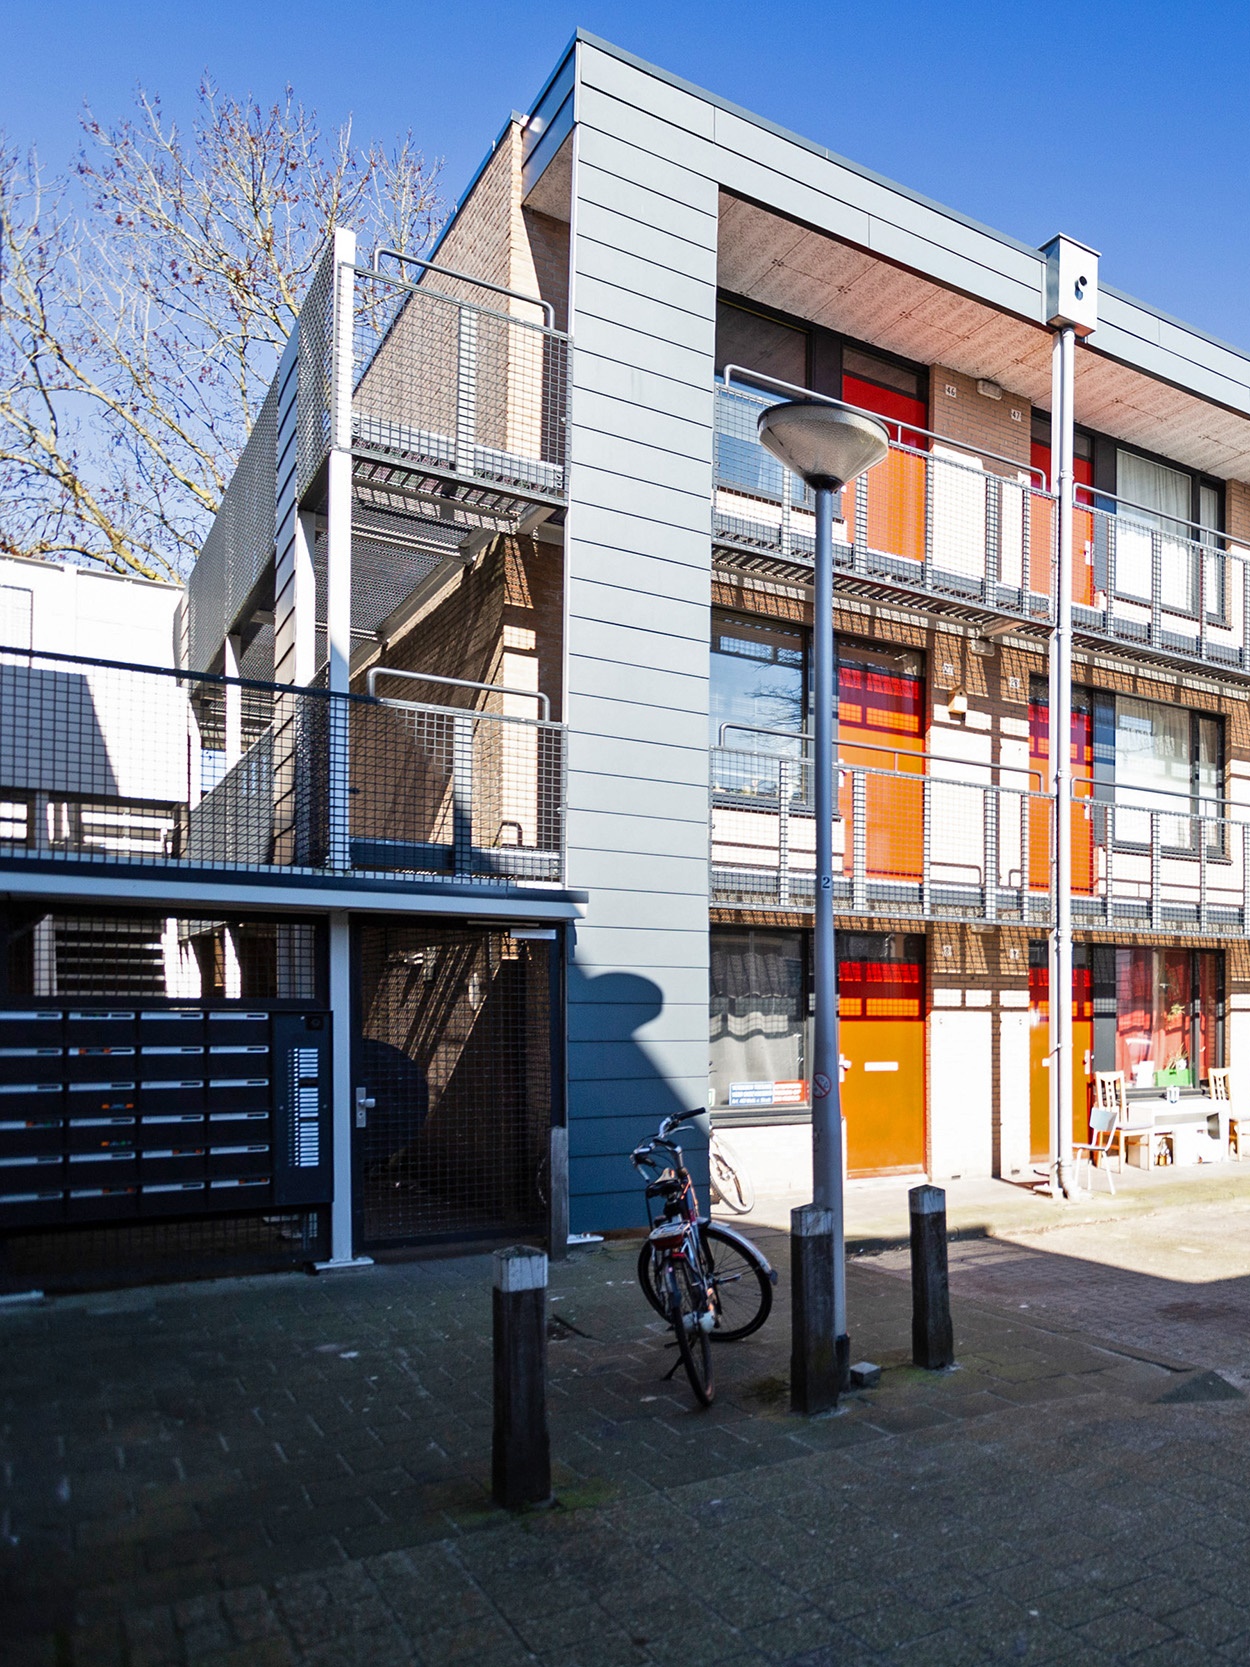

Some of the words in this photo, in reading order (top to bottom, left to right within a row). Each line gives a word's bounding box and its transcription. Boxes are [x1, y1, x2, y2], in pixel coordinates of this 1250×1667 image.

[947, 386, 955, 396] 46
[1012, 411, 1021, 420] 47
[822, 877, 830, 888] 2
